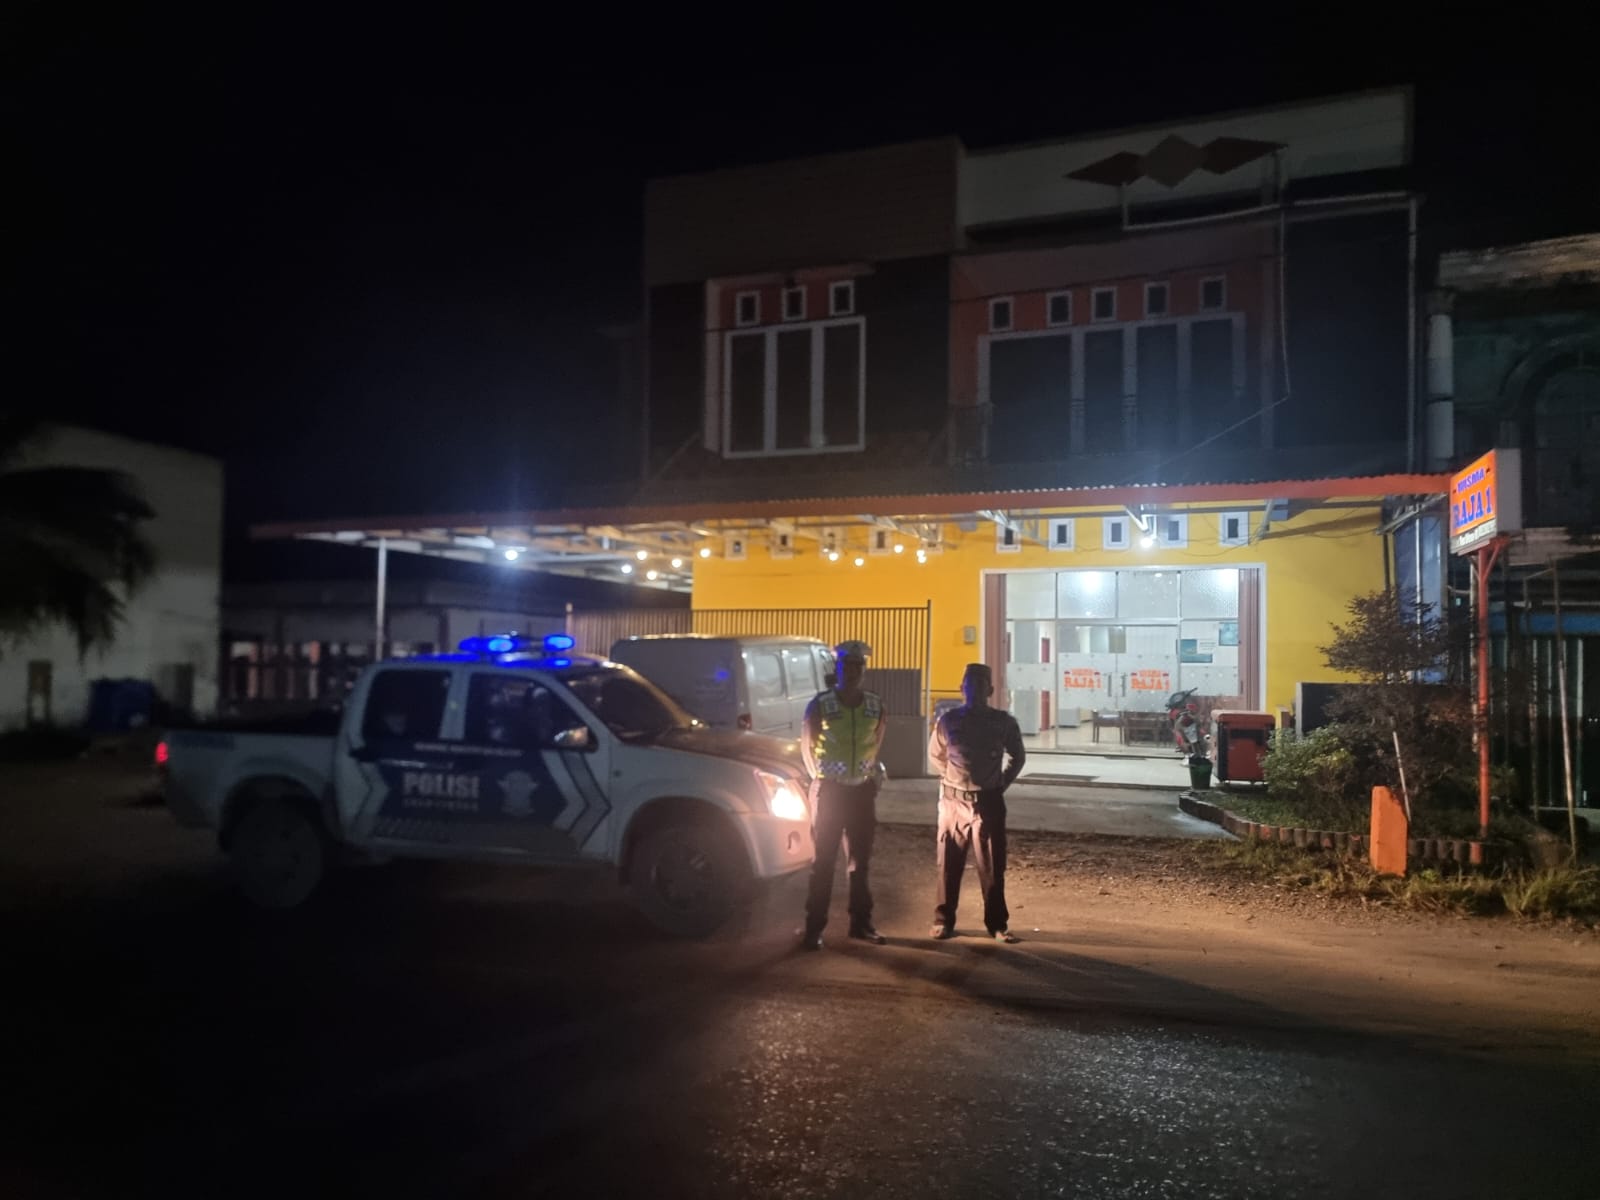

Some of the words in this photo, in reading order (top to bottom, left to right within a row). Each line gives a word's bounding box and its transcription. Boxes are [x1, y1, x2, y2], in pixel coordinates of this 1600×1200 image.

[1452, 491, 1485, 528] RAJA
[1485, 487, 1493, 514] 1
[1064, 677, 1095, 688] RAJA
[1131, 678, 1162, 690] RAJA
[403, 772, 480, 798] POLISI
